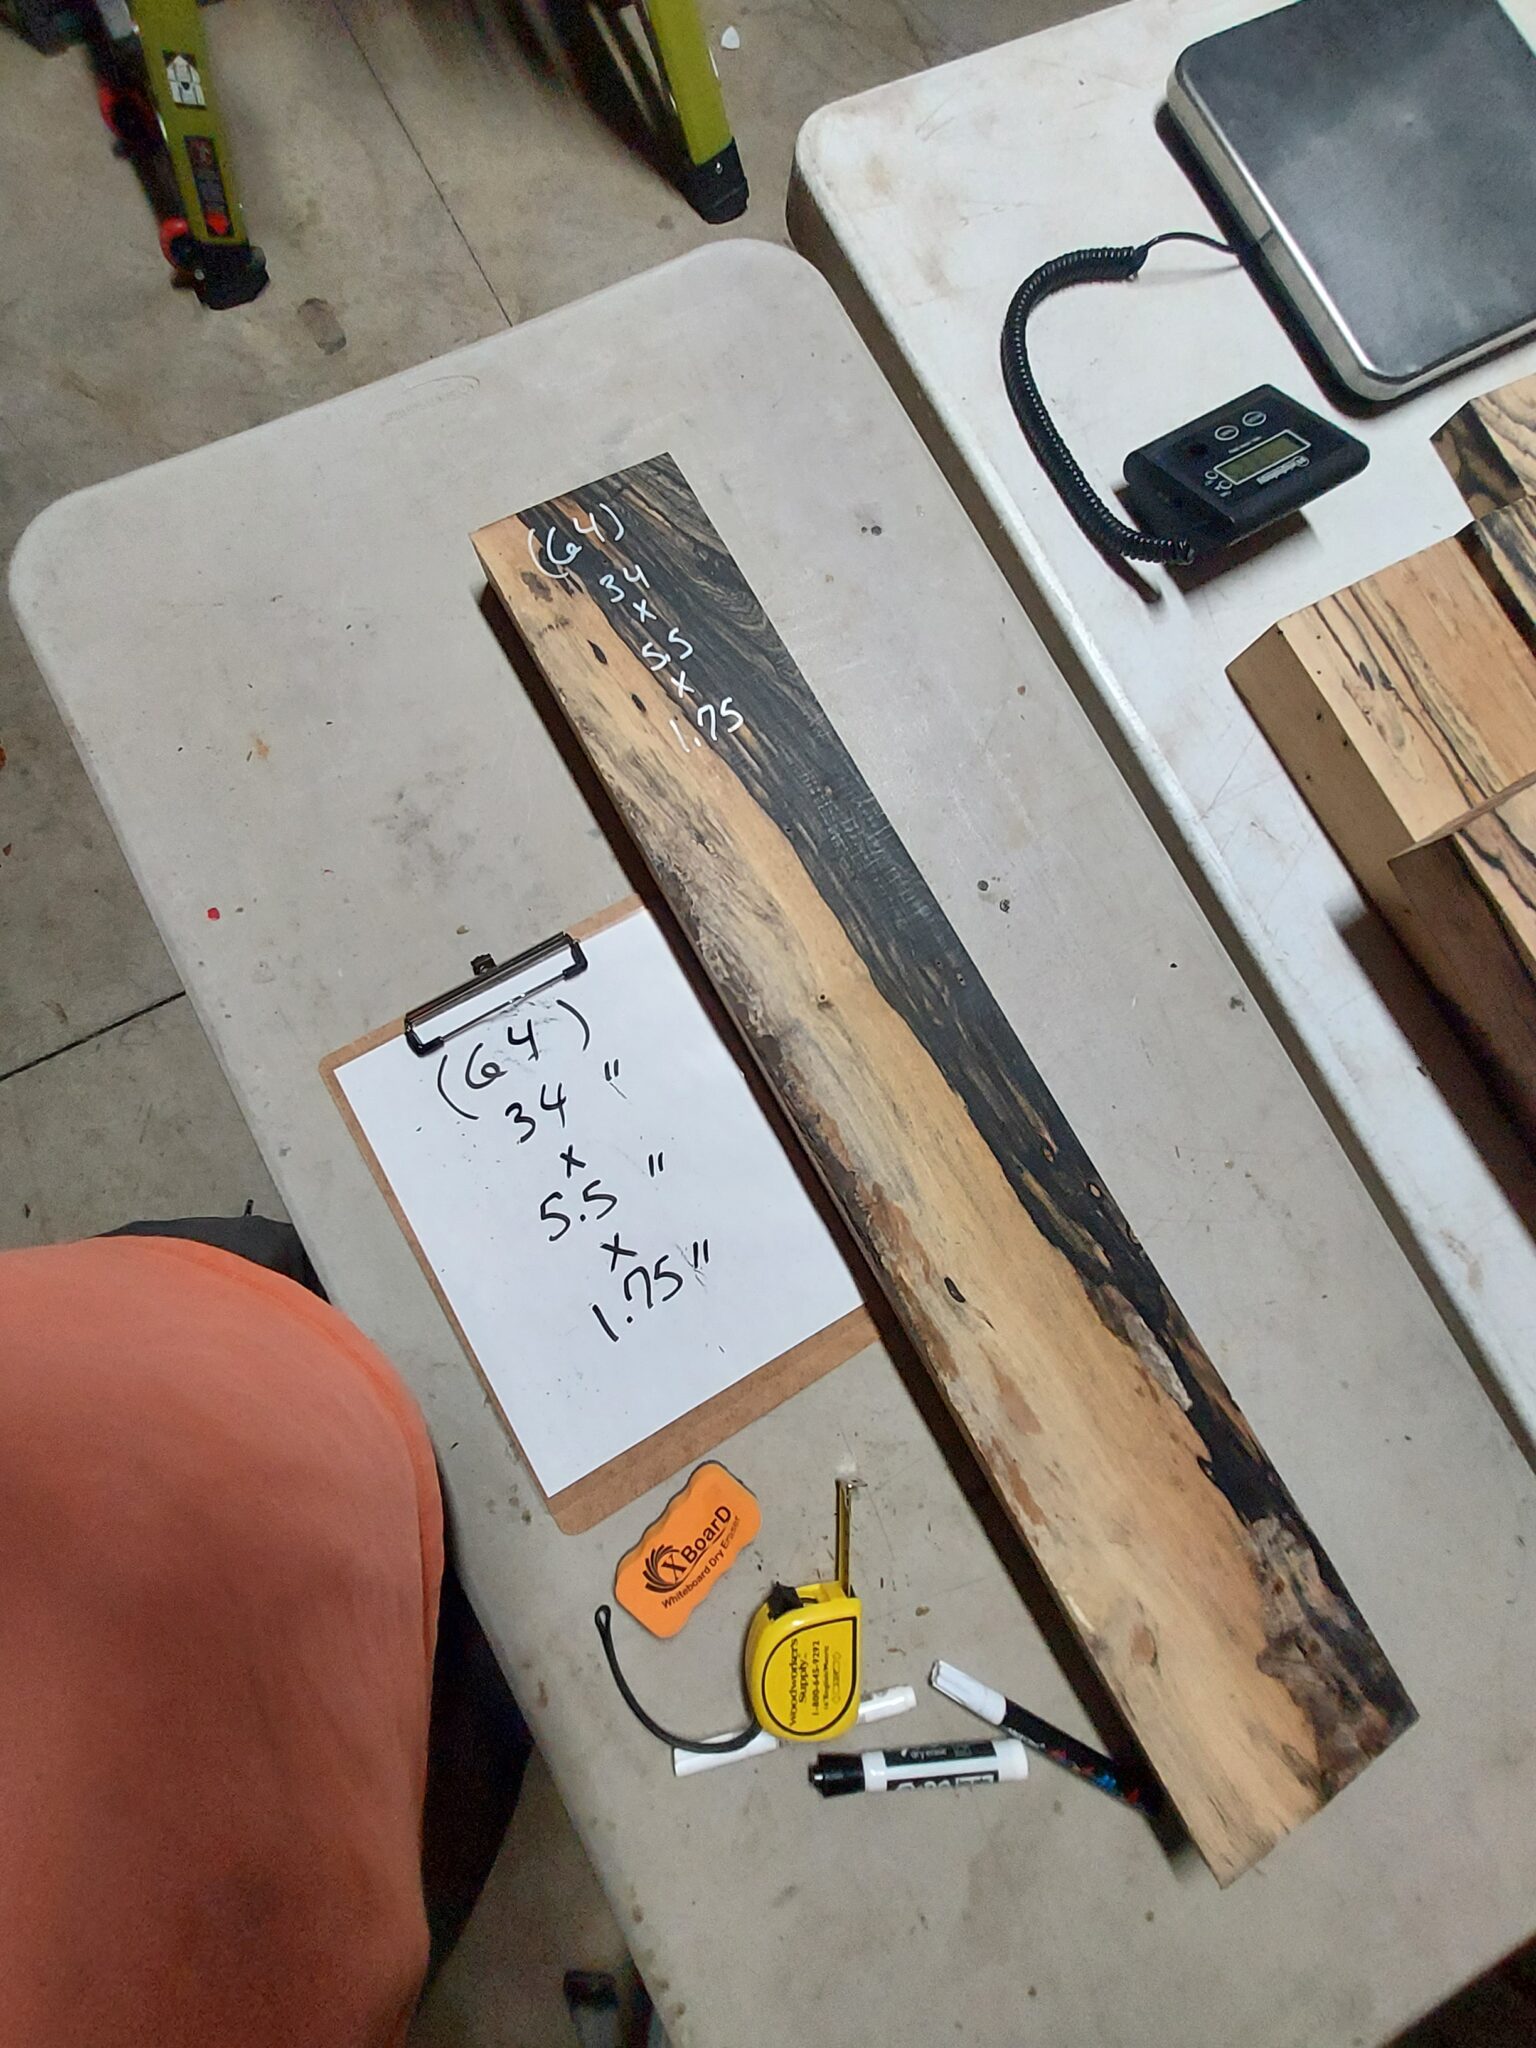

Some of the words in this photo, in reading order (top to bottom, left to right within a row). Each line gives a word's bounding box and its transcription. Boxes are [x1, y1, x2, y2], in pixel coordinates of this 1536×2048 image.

[600, 564, 651, 602] 34
[642, 628, 693, 671] 5.5
[669, 697, 744, 752] 1.75
[661, 1565, 711, 1609] Whiteboard
[709, 1551, 725, 1568] Dry
[721, 1515, 740, 1550] Eraser
[799, 1659, 809, 1703] Supply
